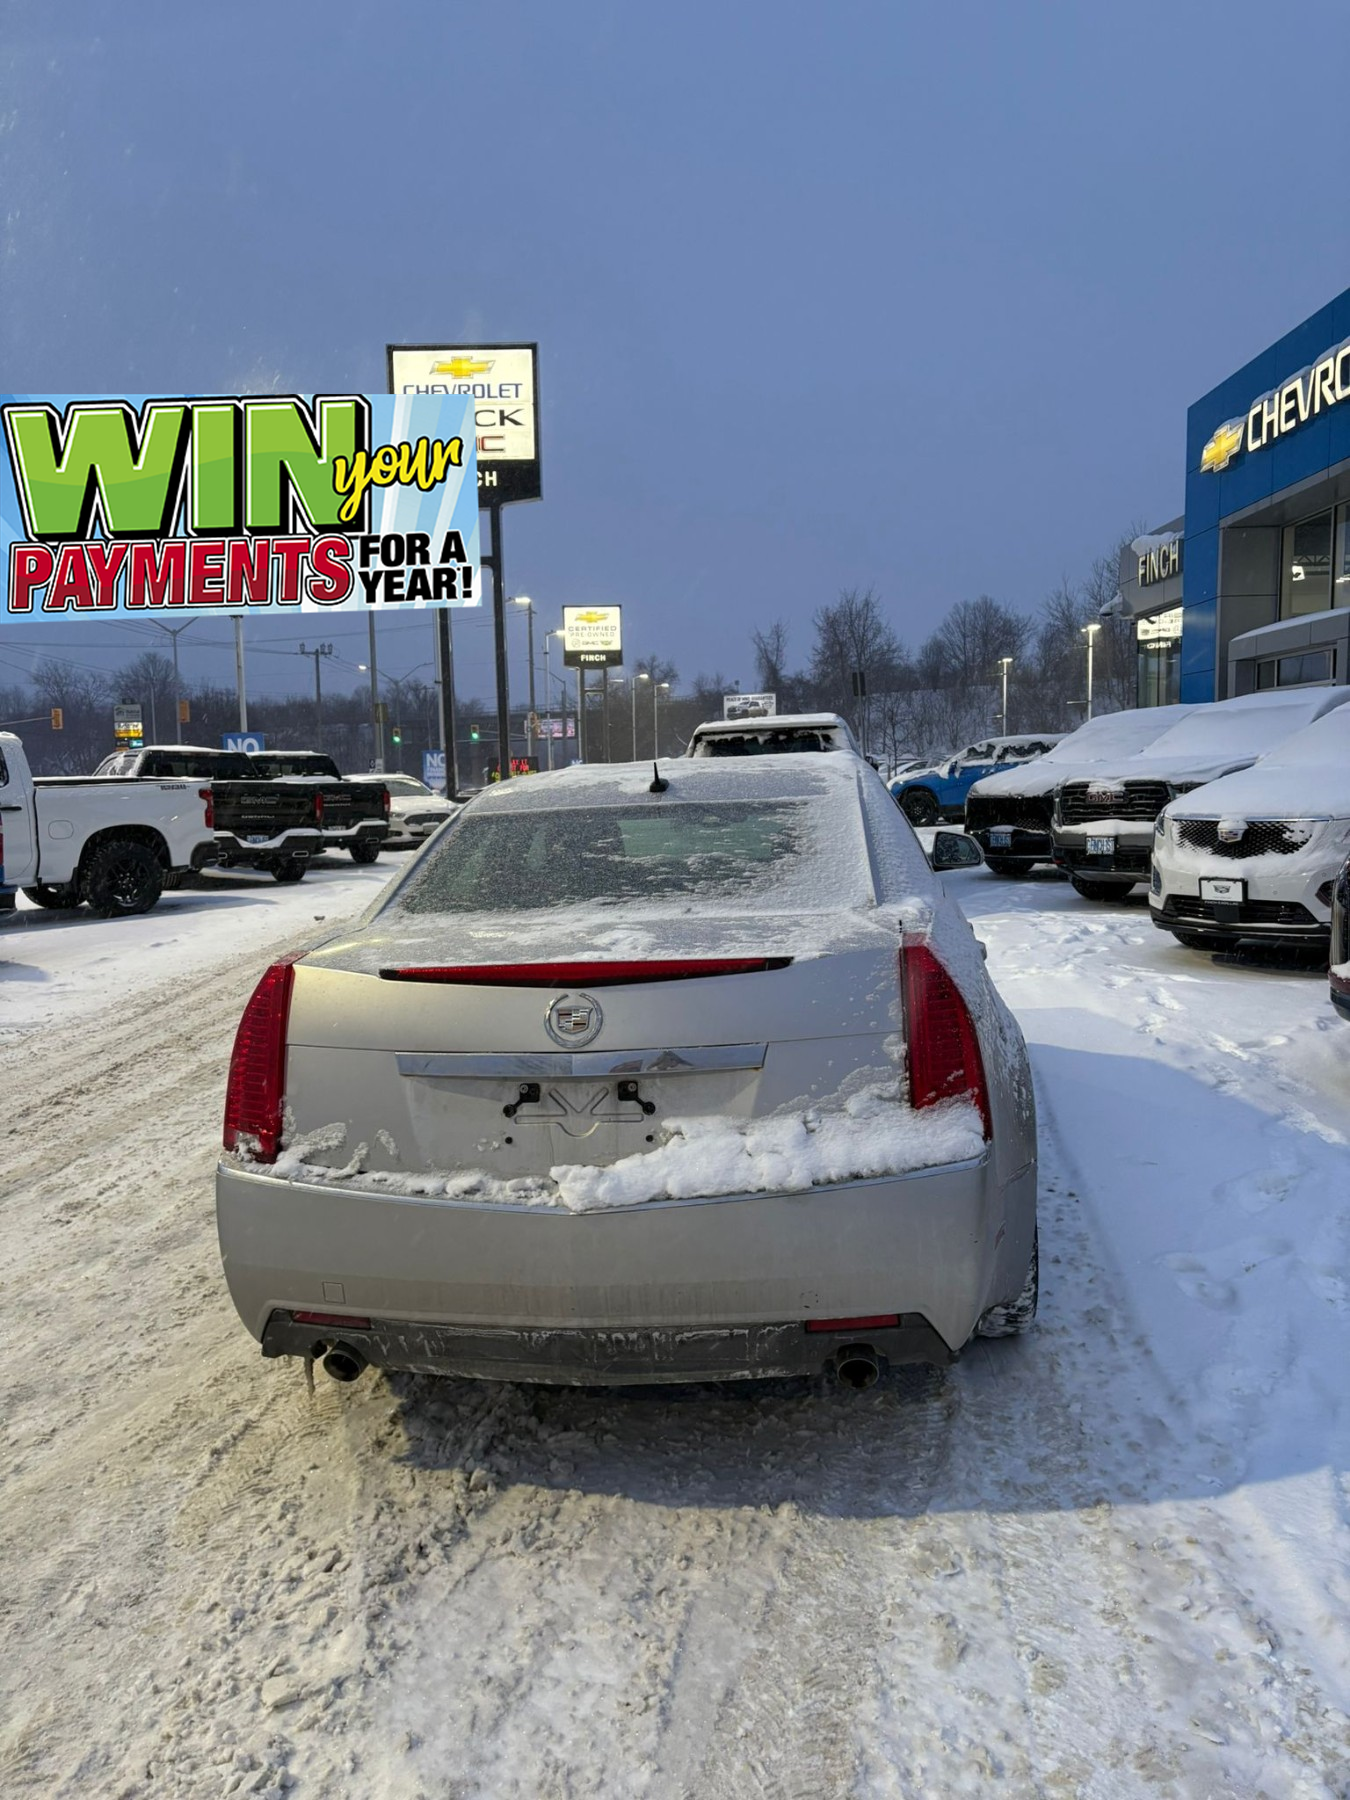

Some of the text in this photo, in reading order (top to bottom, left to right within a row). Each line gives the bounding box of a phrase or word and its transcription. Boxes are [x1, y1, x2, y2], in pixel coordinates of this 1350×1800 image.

[1138, 540, 1179, 587] FINCH
[580, 654, 607, 662] FINCH
[227, 737, 260, 752] NO
